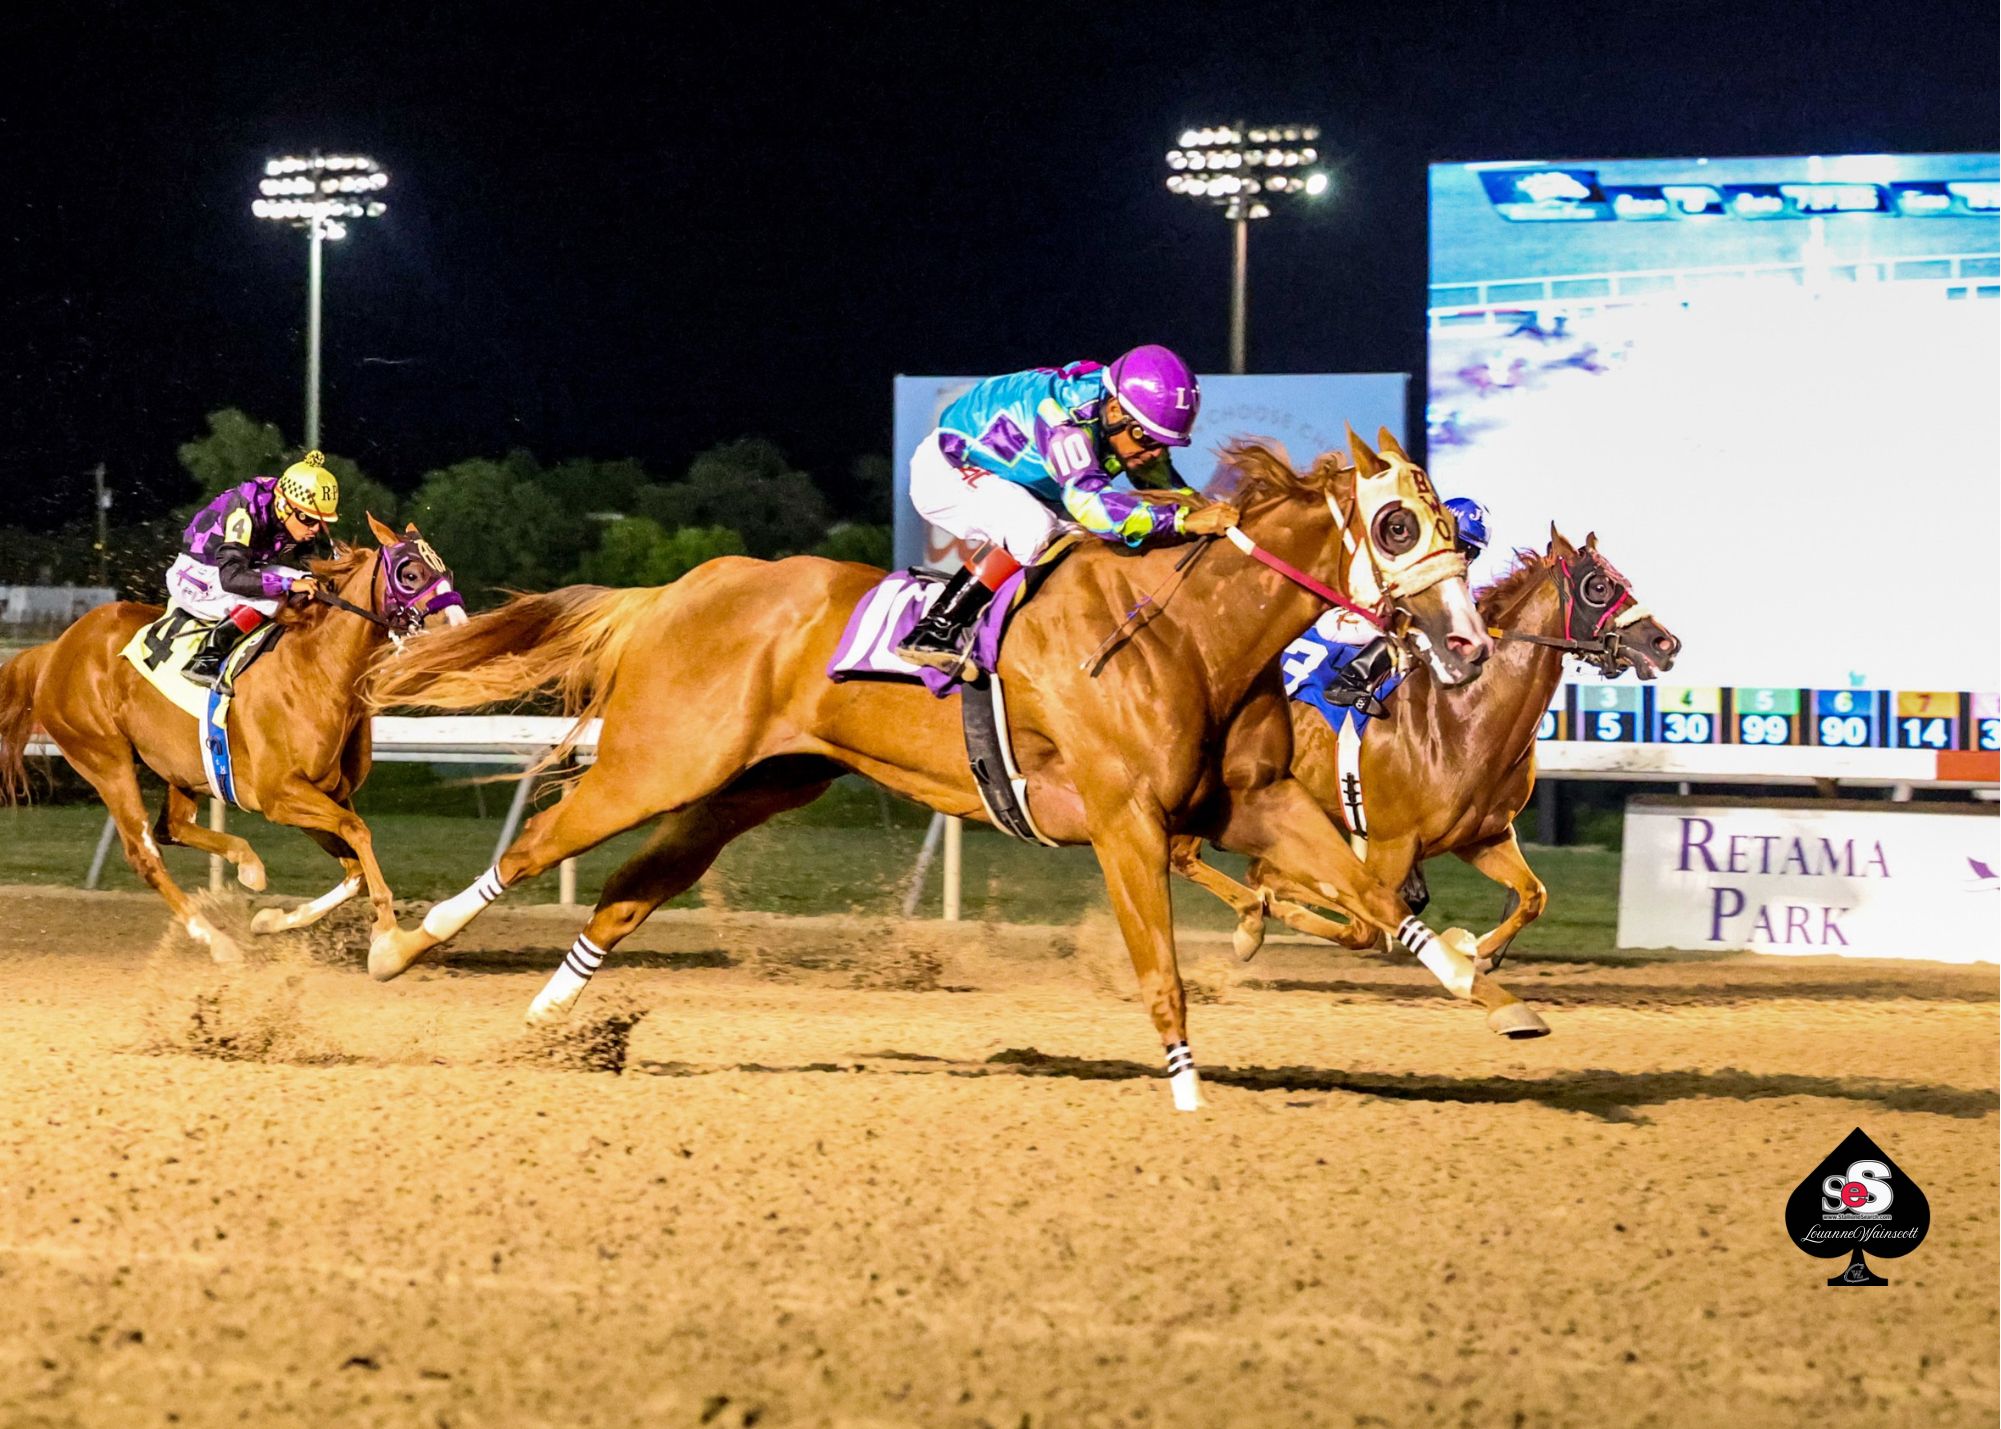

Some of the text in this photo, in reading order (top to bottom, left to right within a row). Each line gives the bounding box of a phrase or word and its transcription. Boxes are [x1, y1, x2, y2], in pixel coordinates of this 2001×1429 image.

[1052, 432, 1092, 477] 10
[232, 518, 245, 540] 4
[143, 606, 189, 672] 4
[832, 578, 947, 674] 10
[1601, 687, 1932, 712] 3 4 5 6 7
[1597, 711, 1622, 741] 5
[1664, 713, 1709, 743] 30
[1742, 714, 1789, 745] 99
[1820, 715, 1868, 746] 90
[1903, 717, 1949, 748] 14
[1675, 816, 1893, 879] RETAMA
[1706, 886, 1851, 946] PARK
